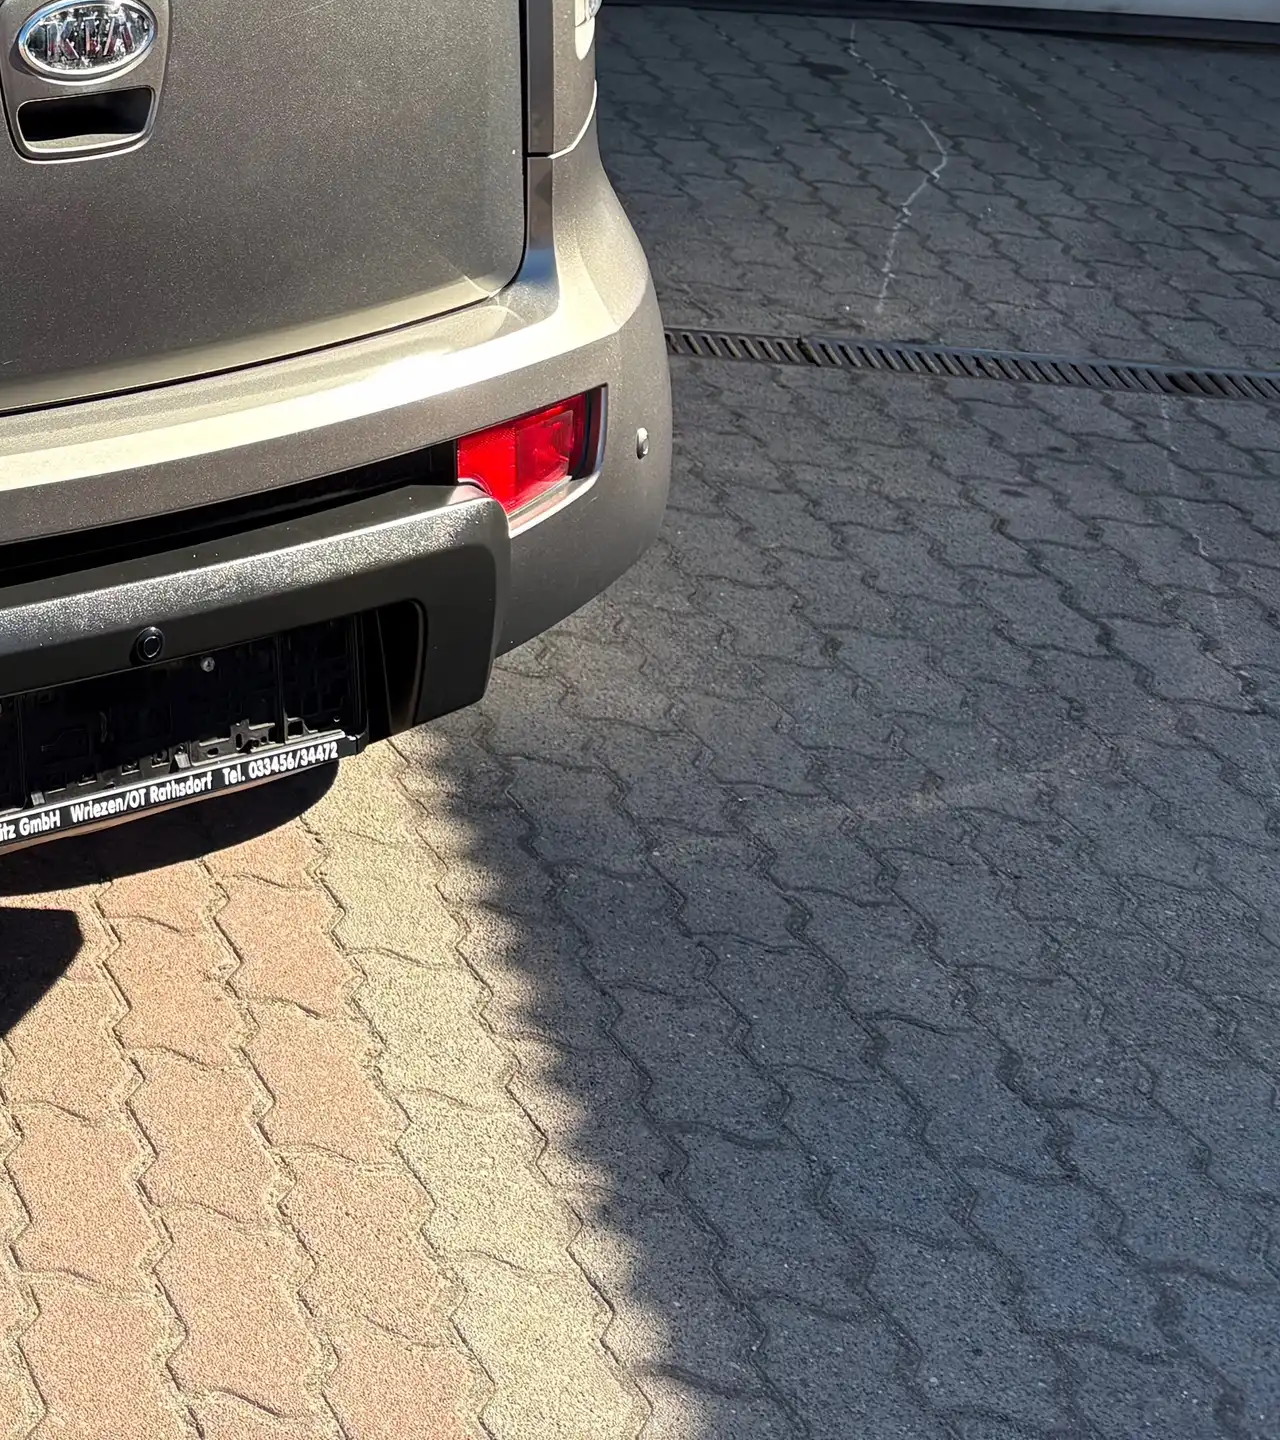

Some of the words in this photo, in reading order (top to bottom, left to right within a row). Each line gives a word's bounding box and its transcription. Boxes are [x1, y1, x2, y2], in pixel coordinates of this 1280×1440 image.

[19, 809, 61, 836] GmbH
[149, 770, 213, 804] Rathsdorf
[223, 766, 246, 785] Tel.
[248, 741, 339, 779] 033456/34472
